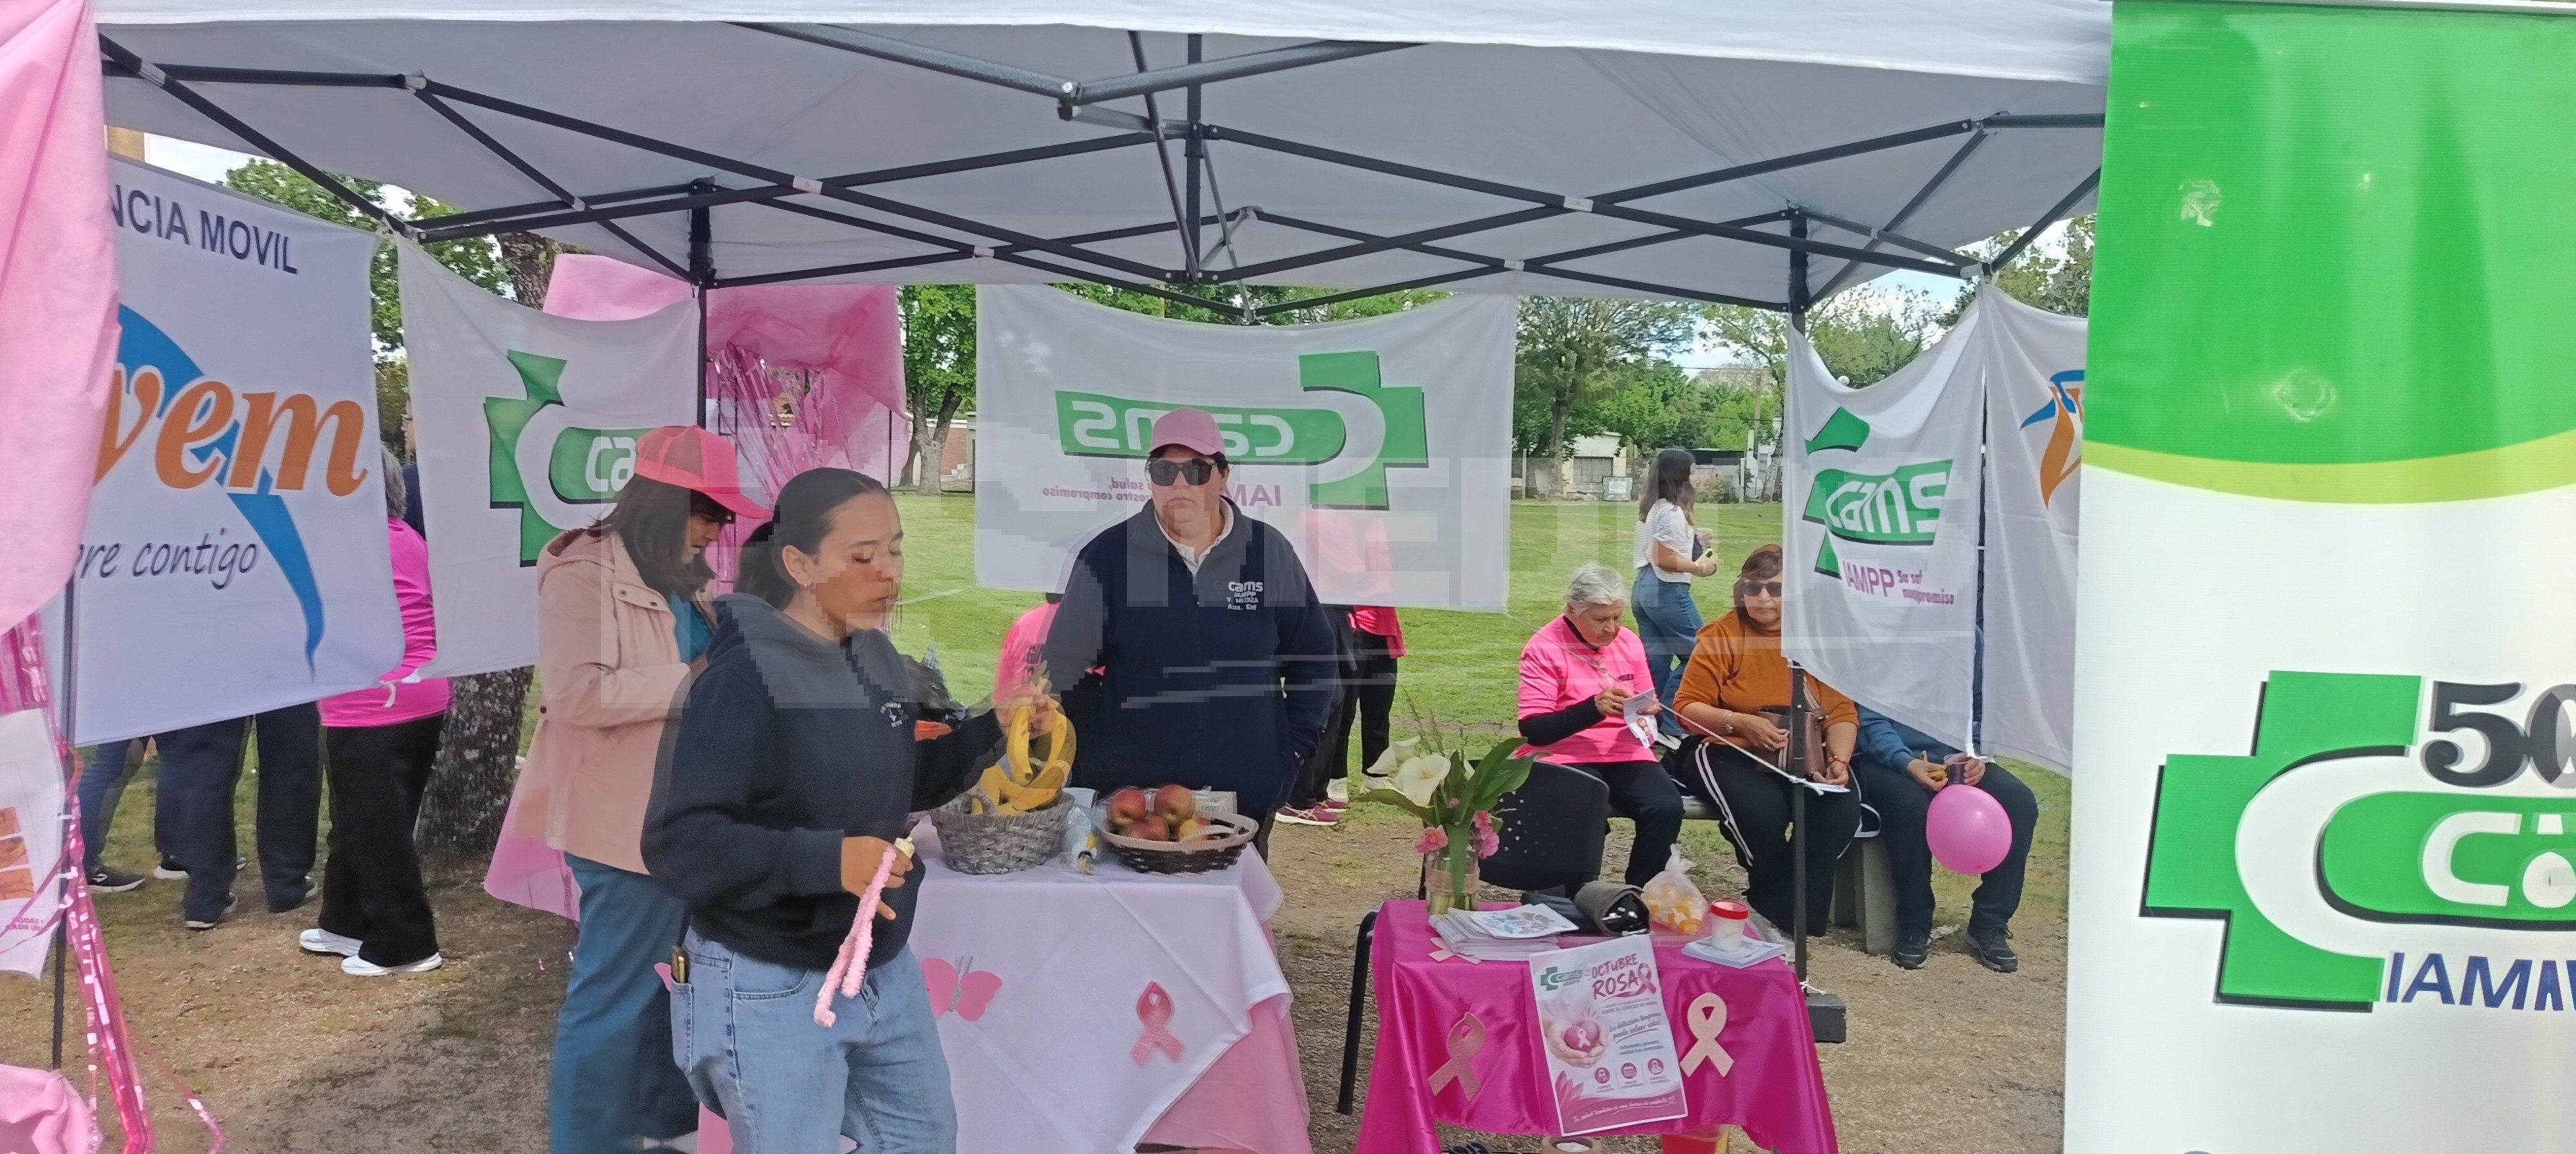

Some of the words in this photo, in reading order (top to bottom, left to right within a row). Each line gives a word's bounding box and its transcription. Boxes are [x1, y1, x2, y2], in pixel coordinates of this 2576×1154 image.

[200, 209, 298, 275] MOVIL
[1826, 471, 1947, 534] cams
[133, 527, 259, 590] contigo
[1228, 582, 1264, 592] cams
[1591, 953, 1640, 979] OCTUBRE
[1591, 969, 1639, 1000] ROSA
